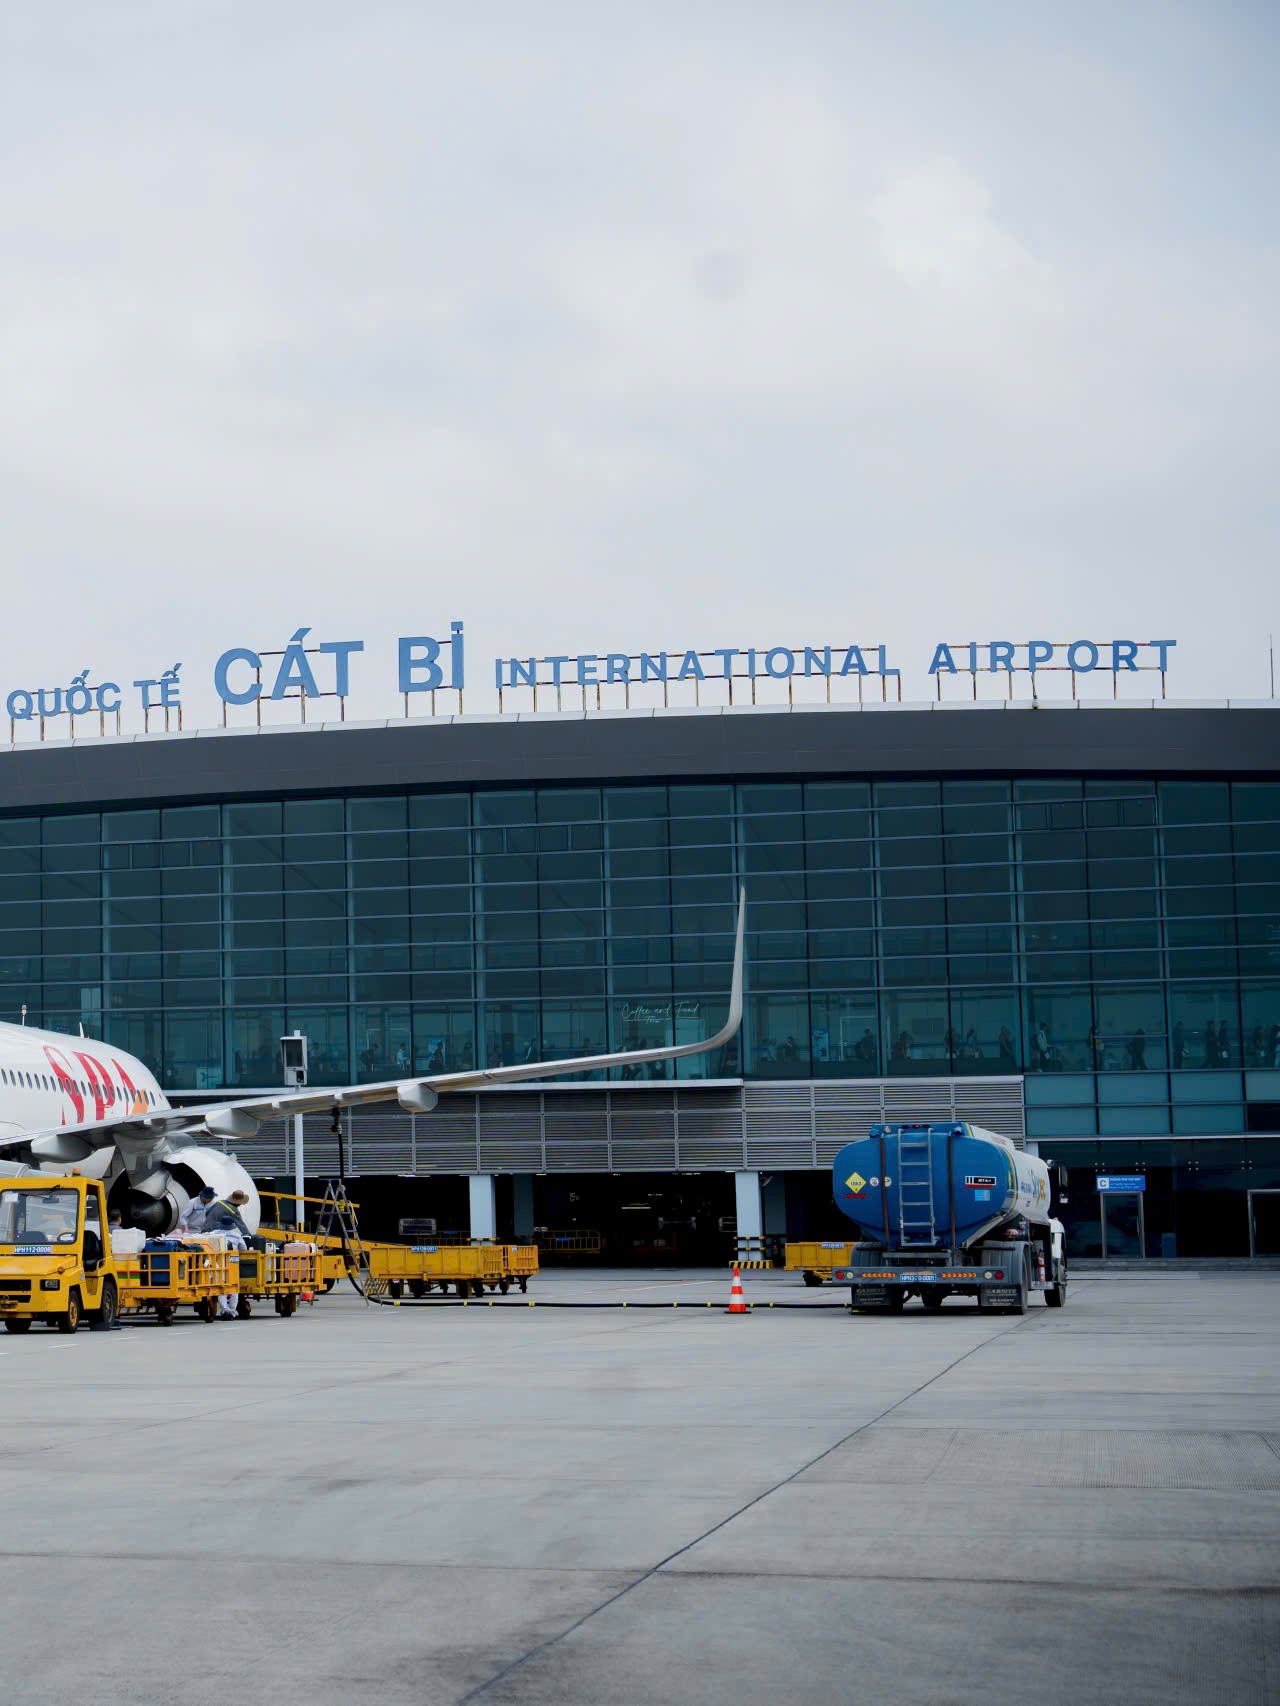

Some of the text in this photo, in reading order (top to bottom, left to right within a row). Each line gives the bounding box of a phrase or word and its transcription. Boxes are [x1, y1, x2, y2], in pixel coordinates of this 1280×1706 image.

[6, 669, 121, 720] QUỐC
[133, 663, 181, 709] TẾ
[215, 628, 364, 705] CÁT
[495, 644, 900, 688] INTERNATIONAL
[928, 640, 1177, 675] AIRPORT
[1099, 1179, 1107, 1188] C
